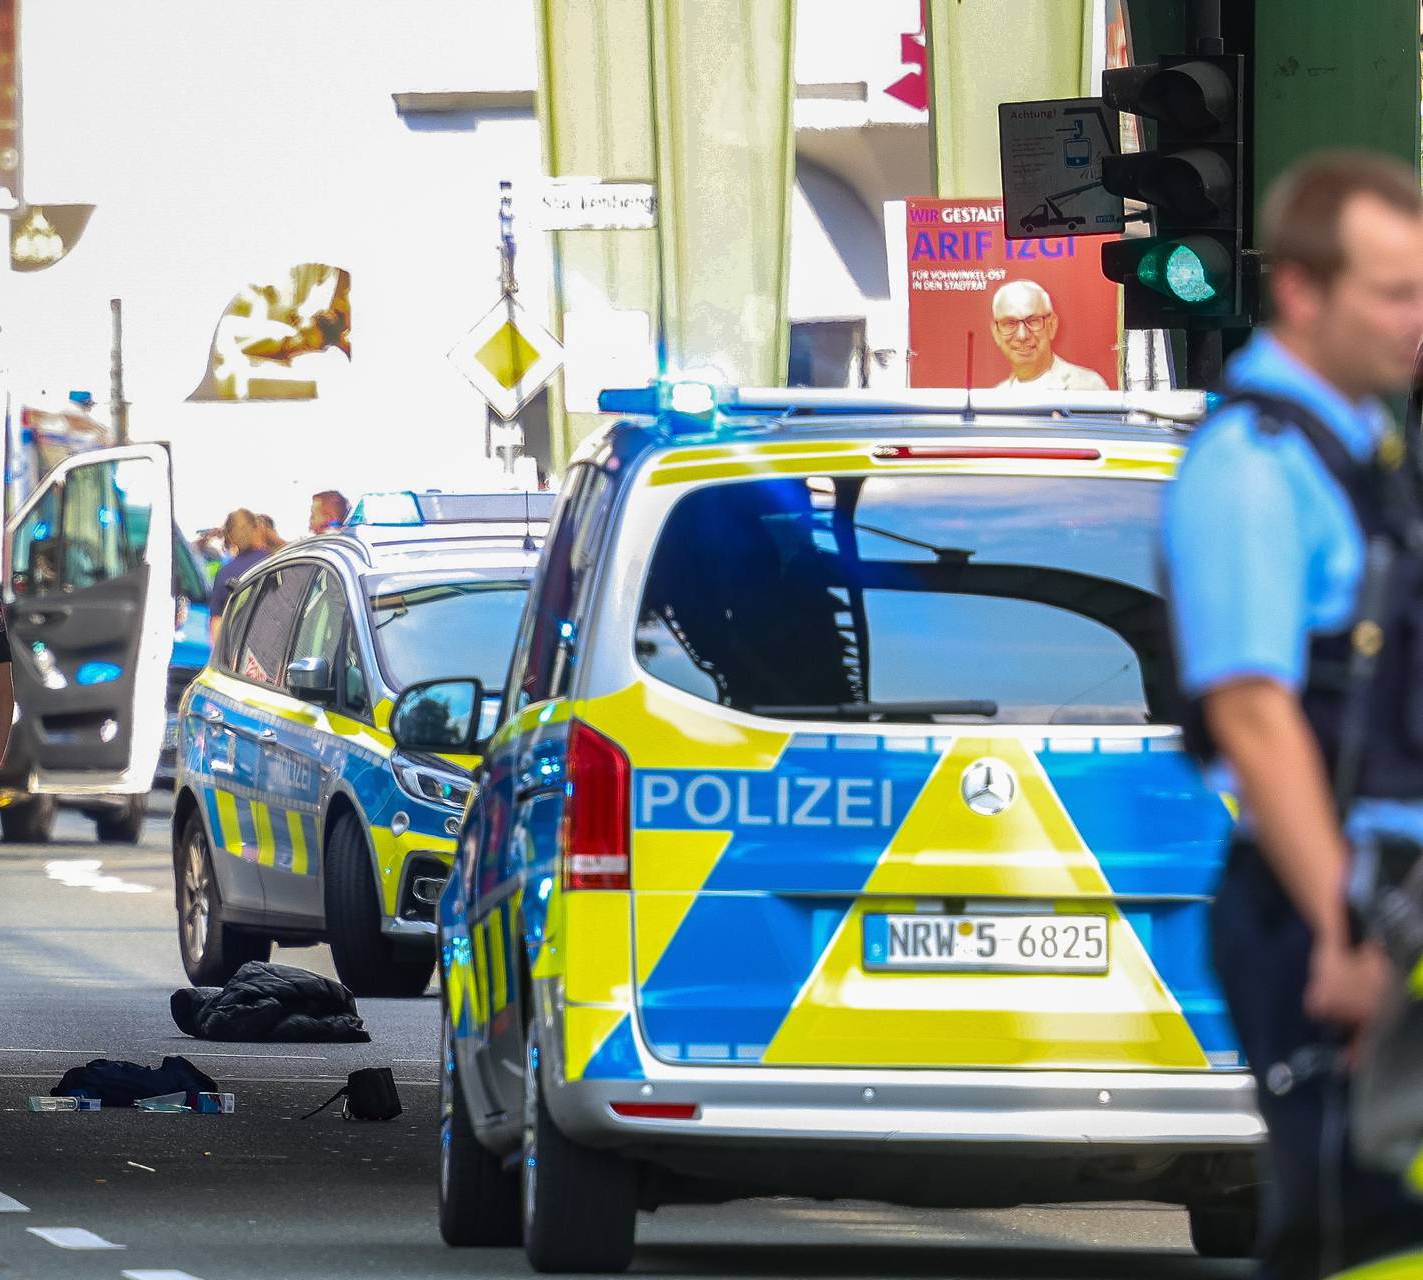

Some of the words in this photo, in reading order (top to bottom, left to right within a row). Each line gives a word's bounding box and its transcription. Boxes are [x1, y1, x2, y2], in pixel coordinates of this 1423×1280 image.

[1010, 108, 1057, 120] Achtung!
[910, 208, 938, 222] WIR
[911, 230, 993, 261] ARIF
[641, 774, 893, 827] POLIZEI
[888, 921, 956, 958] NRW
